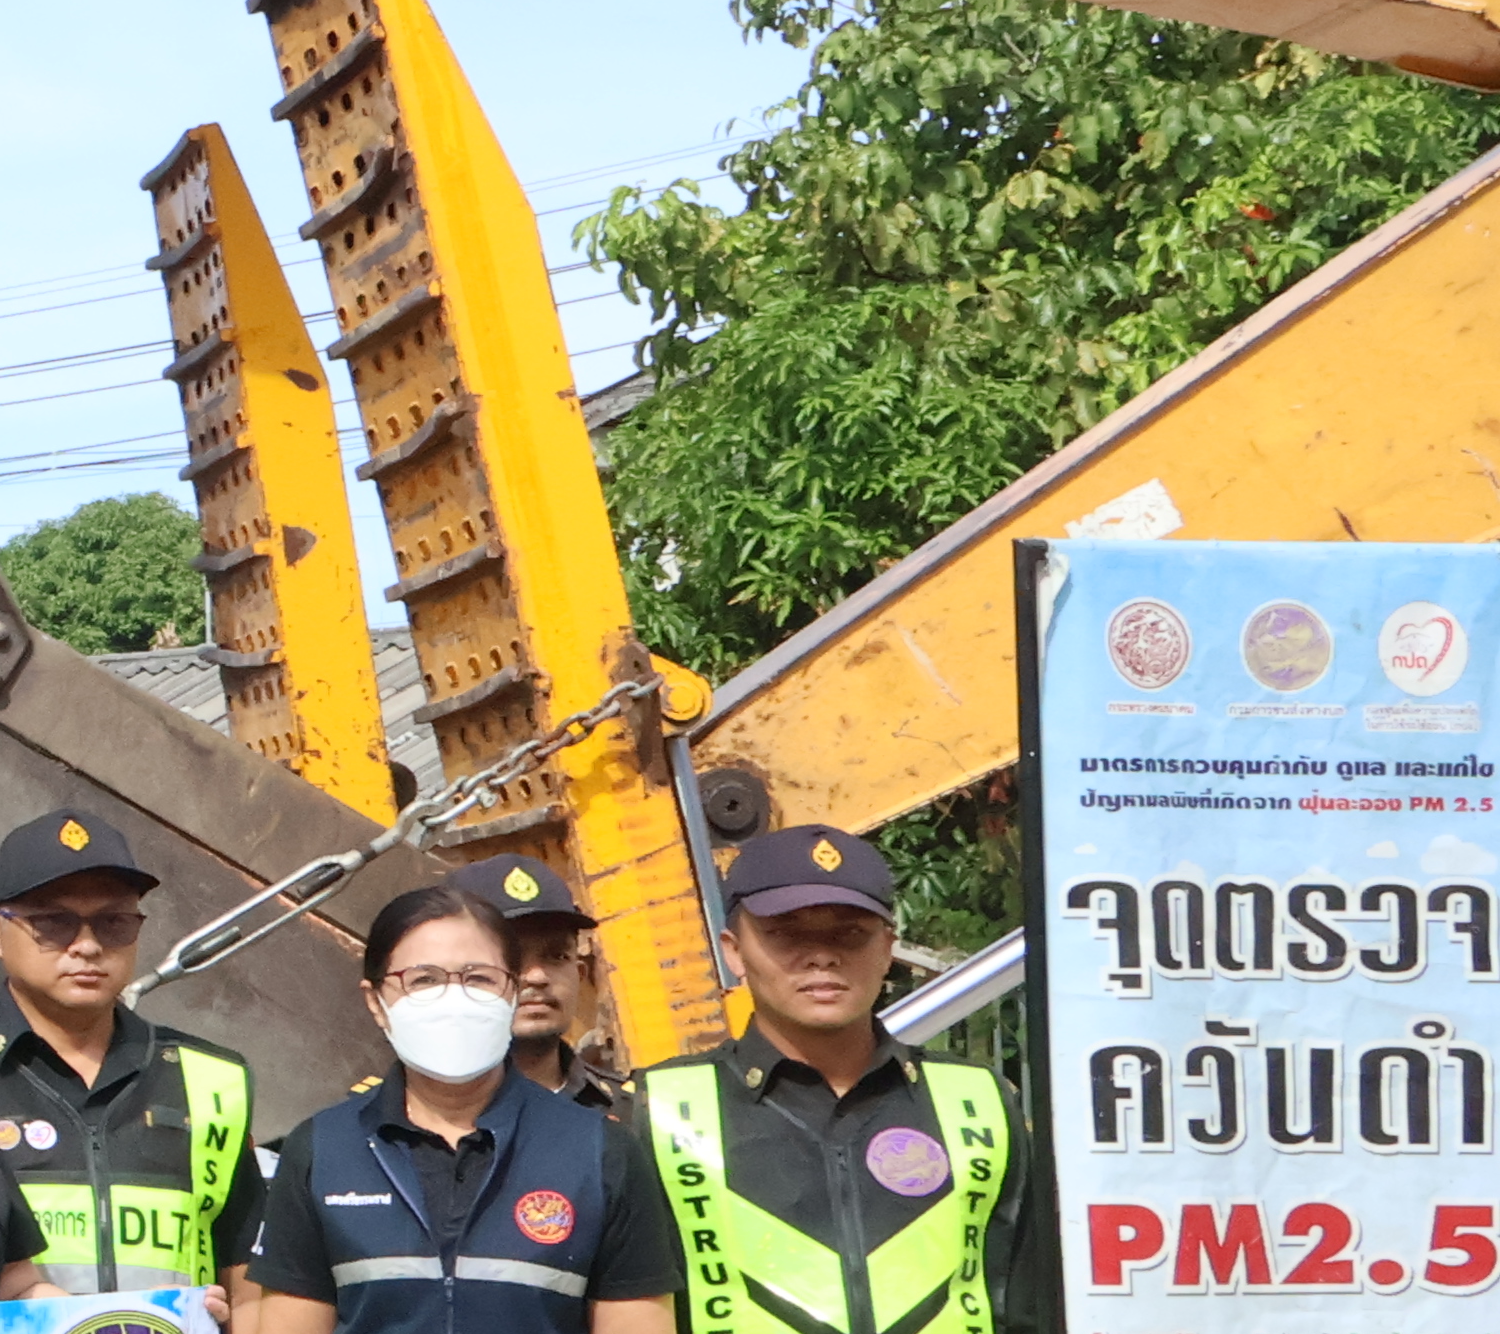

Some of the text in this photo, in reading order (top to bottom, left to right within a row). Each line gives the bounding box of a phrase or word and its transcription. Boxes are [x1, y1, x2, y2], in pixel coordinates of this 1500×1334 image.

[1409, 796, 1445, 812] PM
[1453, 796, 1494, 812] 2.5
[1066, 879, 1494, 990] จุดตรวจ
[1089, 1019, 1486, 1147] ควันดำ
[118, 1205, 190, 1254] DLT
[1086, 1203, 1500, 1287] PM2.5
